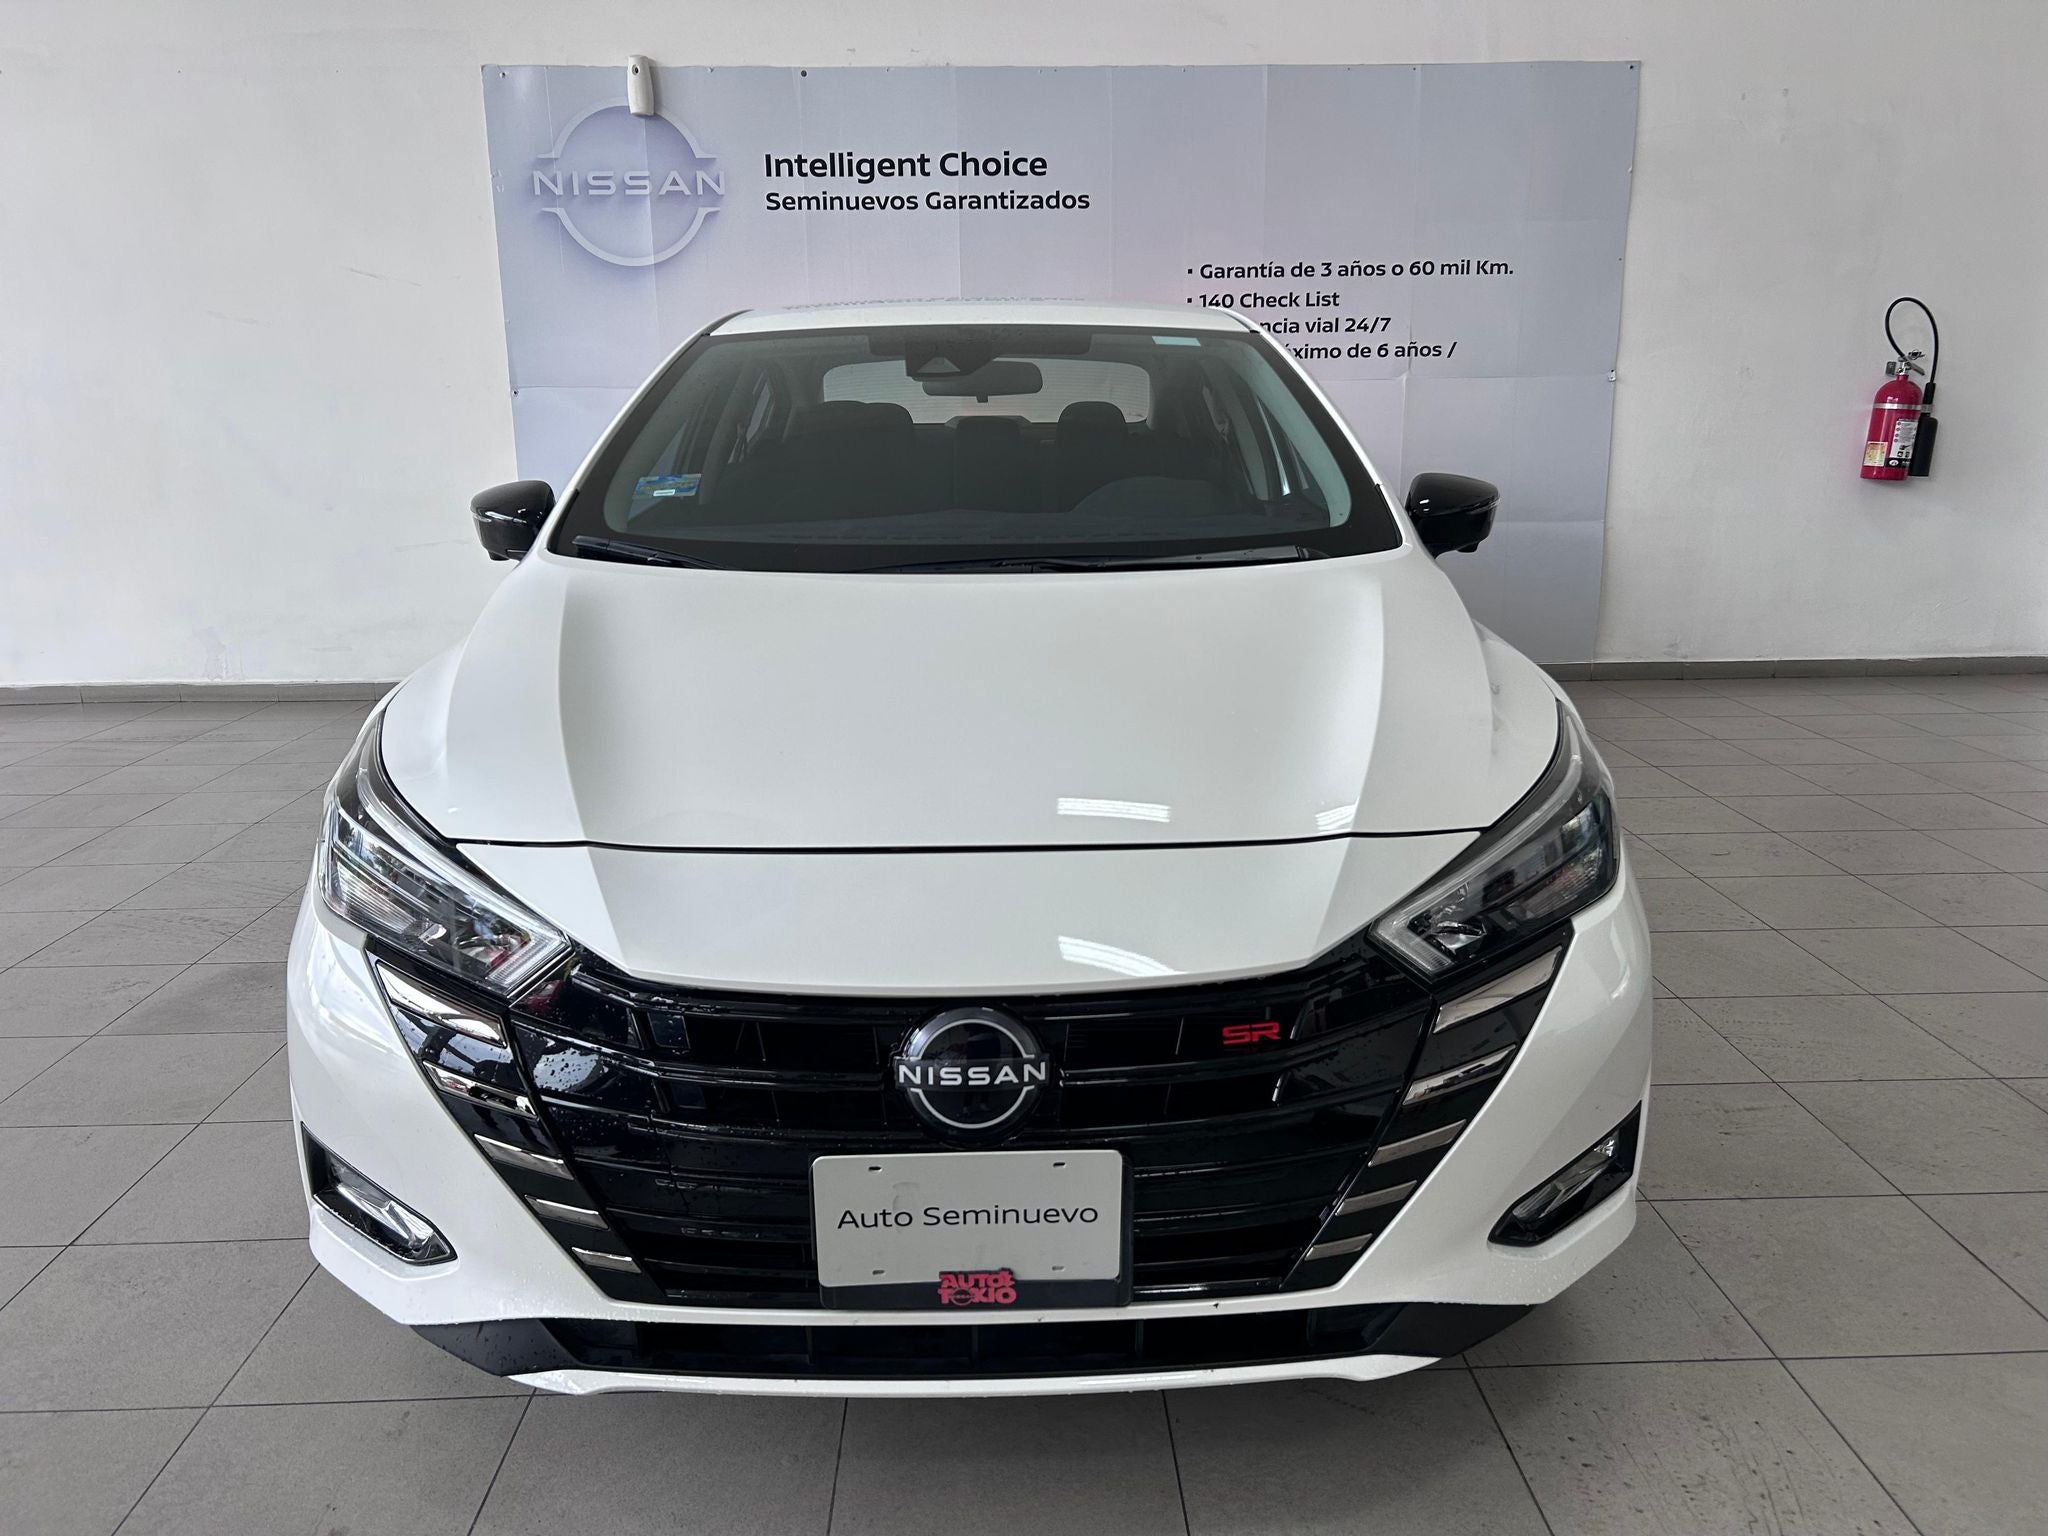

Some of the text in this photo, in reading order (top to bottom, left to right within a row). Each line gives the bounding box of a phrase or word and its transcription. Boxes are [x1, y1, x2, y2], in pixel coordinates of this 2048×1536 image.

[765, 150, 1048, 184] Intelligent Choice
[532, 170, 726, 196] NISSAN
[765, 189, 1091, 211] Seminuevos Garantizados
[1199, 259, 1514, 279] Garantía de 3 años o 60 mil Km.
[1199, 291, 1340, 309] 140 Check List
[1305, 317, 1340, 333] vial
[1344, 316, 1392, 333] 24/7
[1346, 343, 1372, 359] de
[1376, 343, 1389, 358] 6
[1394, 341, 1443, 358] años
[1222, 1021, 1282, 1045] SR
[898, 1061, 1046, 1087] NISSAN
[837, 1205, 1099, 1230] Auto Seminuevo
